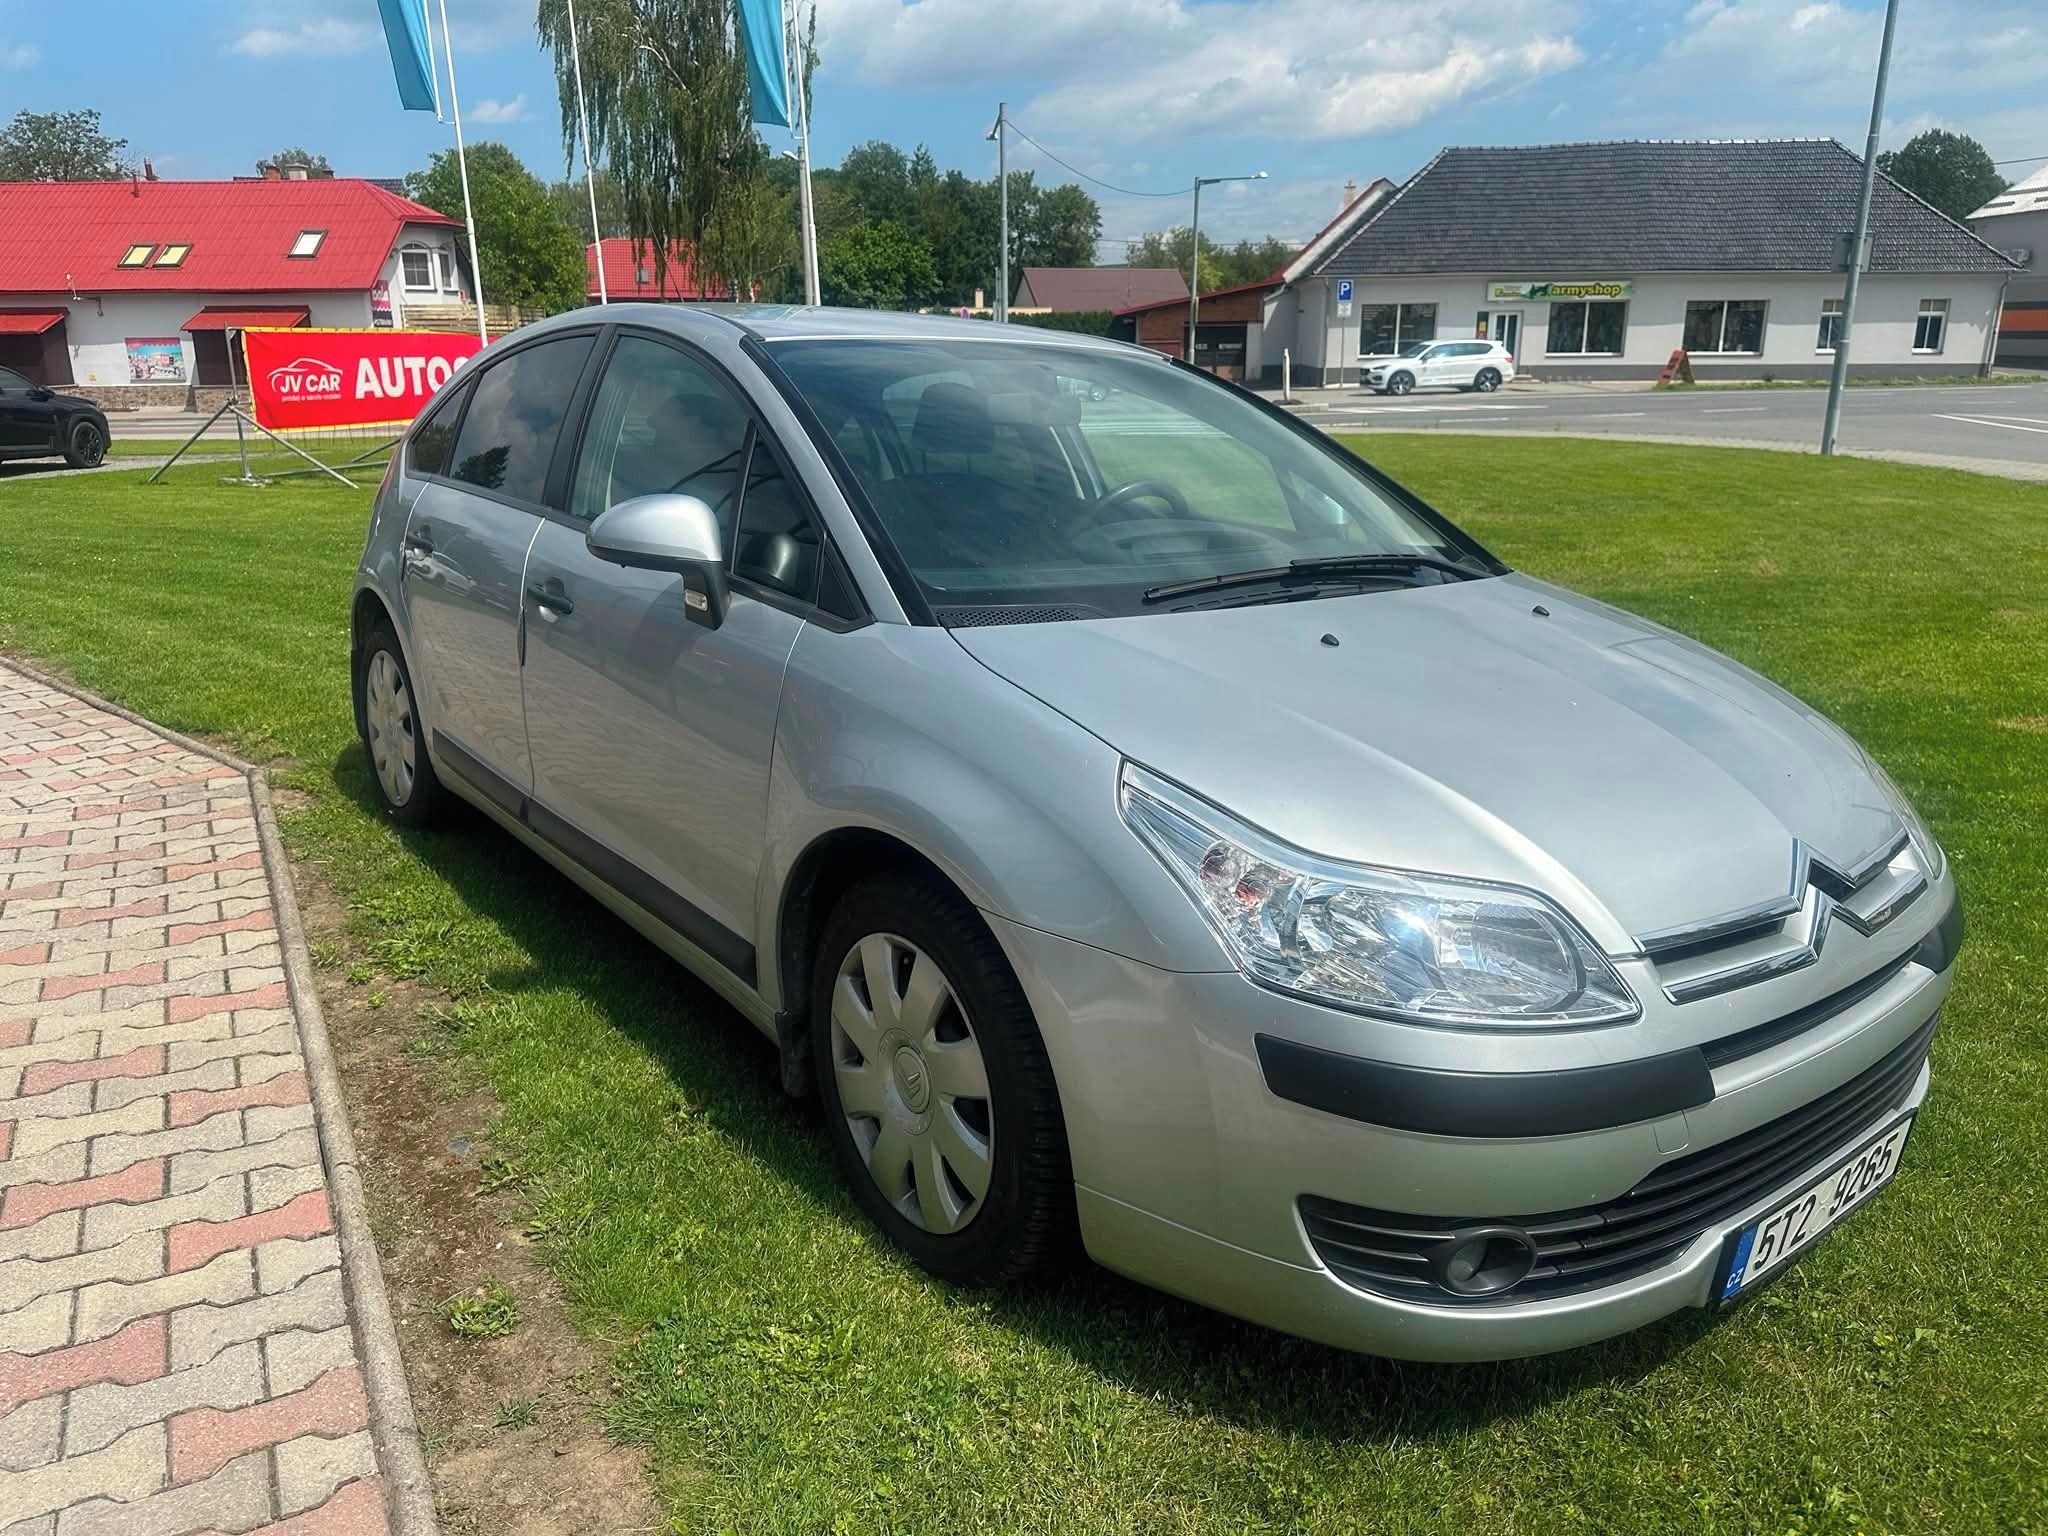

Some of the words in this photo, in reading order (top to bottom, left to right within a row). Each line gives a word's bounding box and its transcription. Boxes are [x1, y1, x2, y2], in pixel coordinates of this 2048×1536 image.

[1340, 282, 1350, 295] P
[1551, 283, 1621, 298] armyshop
[280, 375, 302, 393] JV
[305, 374, 340, 392] CAR
[1753, 1194, 1817, 1271] 5T2
[1829, 1133, 1899, 1217] 9265
[1727, 1268, 1743, 1289] CZ
